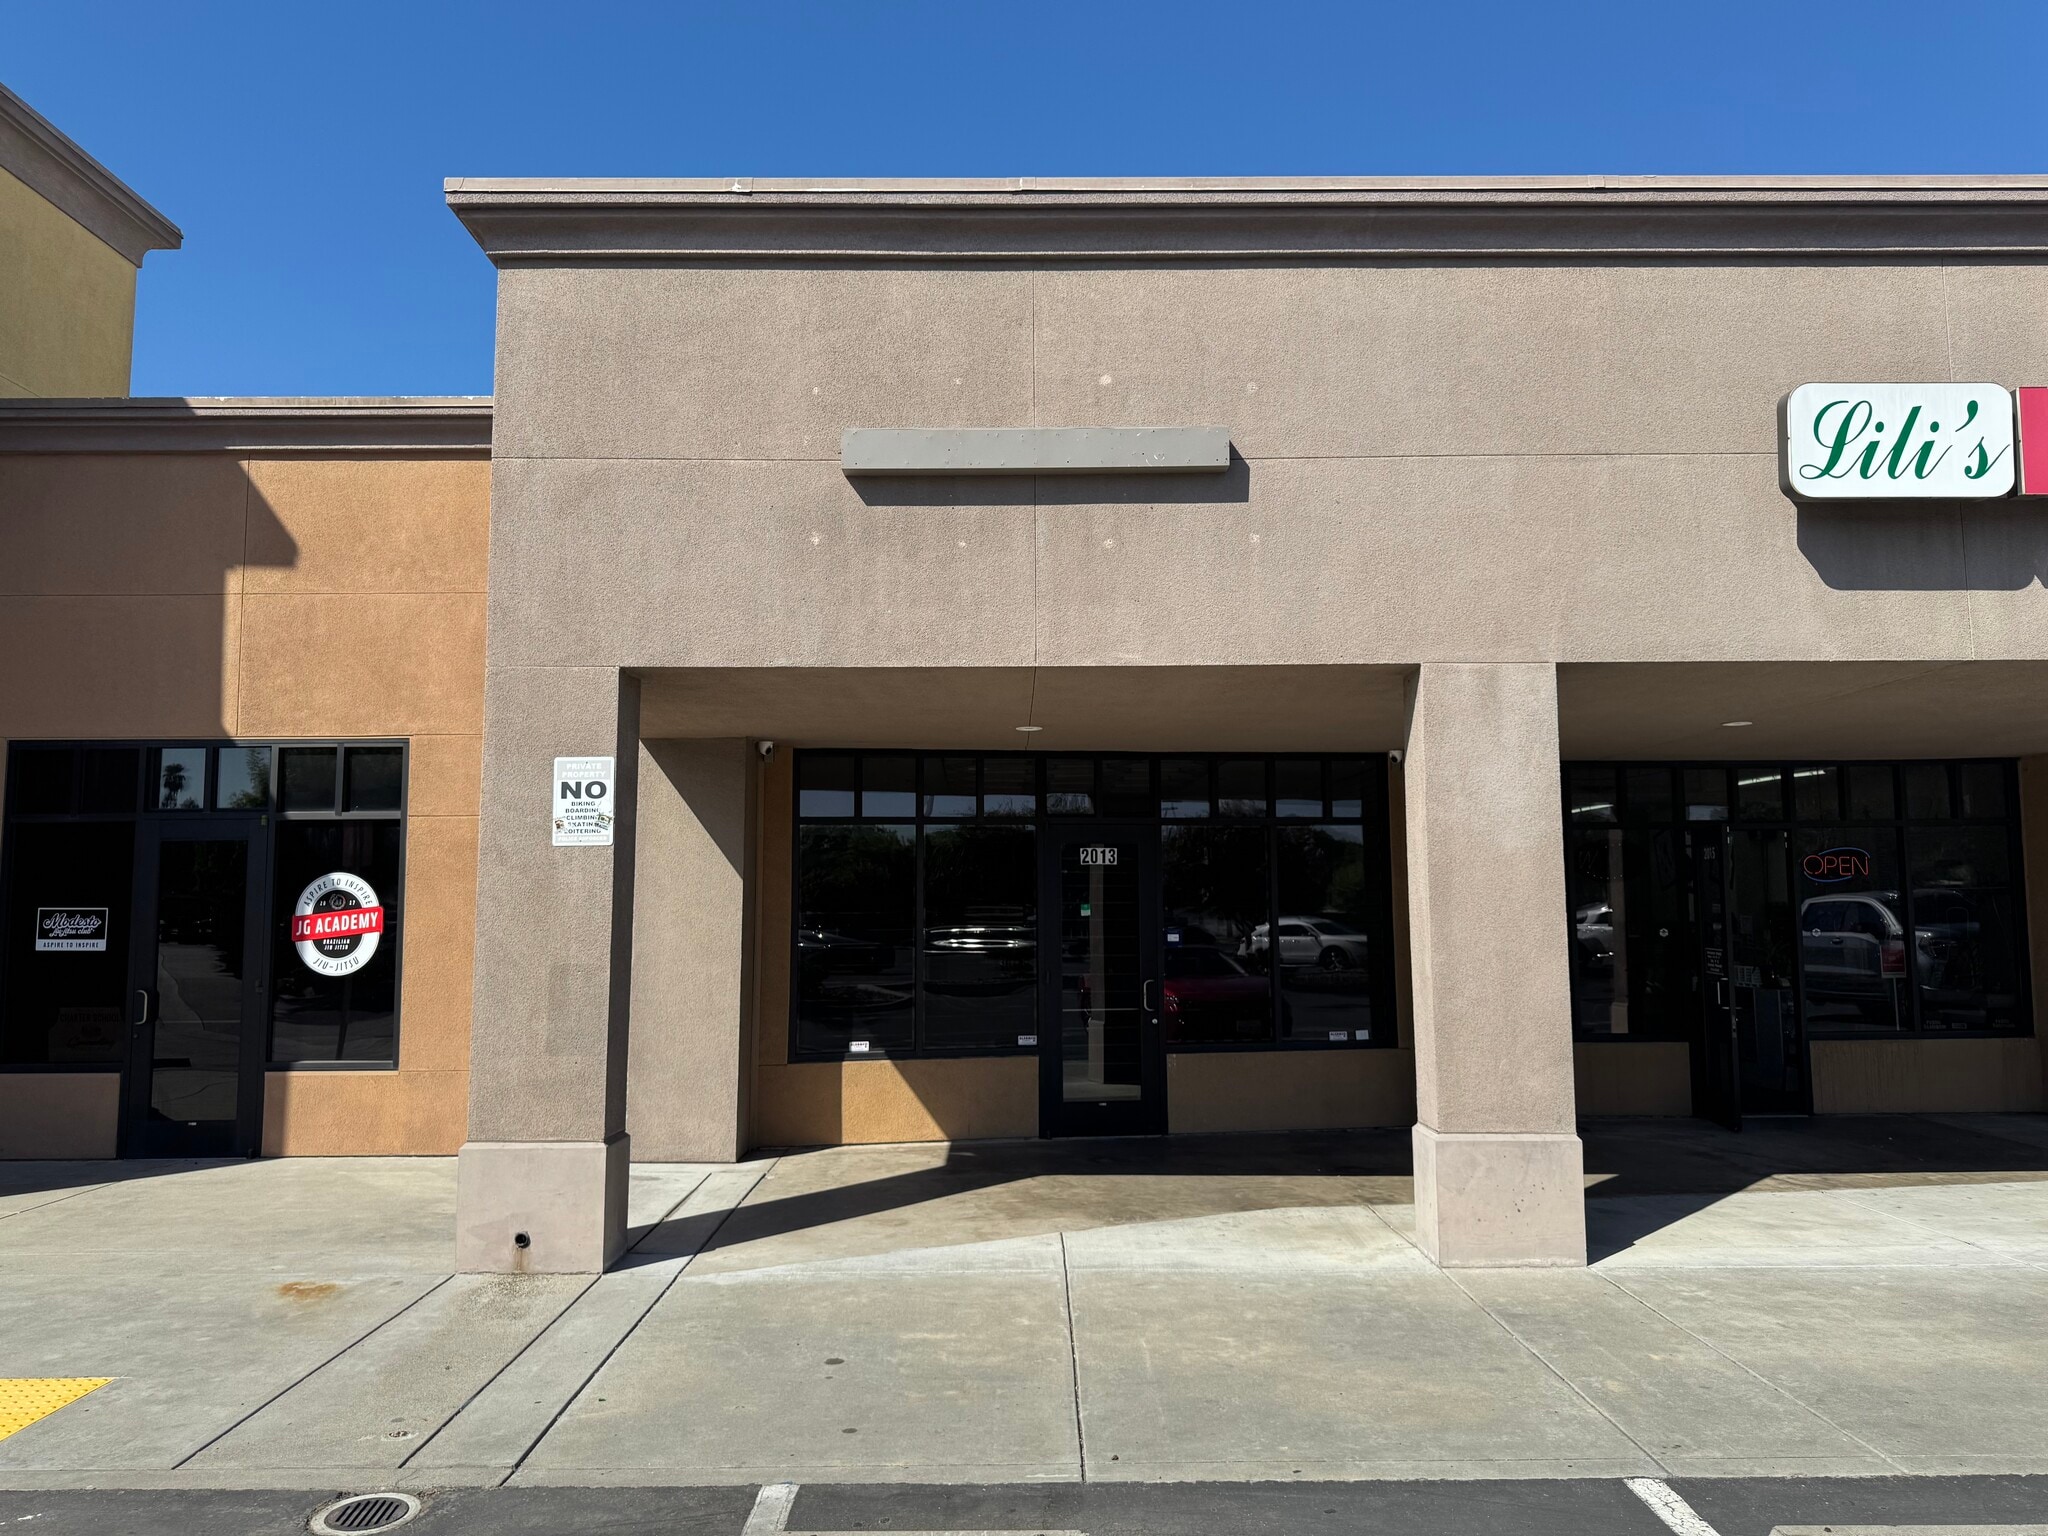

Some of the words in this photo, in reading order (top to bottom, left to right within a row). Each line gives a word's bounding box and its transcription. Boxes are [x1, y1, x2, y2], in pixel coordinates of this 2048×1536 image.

[1800, 400, 2010, 480] Lili's
[561, 781, 607, 799] NO
[1081, 848, 1116, 864] 2013
[1803, 855, 1869, 876] OPEN
[304, 881, 328, 907] ASPIRE
[331, 878, 341, 886] TO
[345, 879, 373, 905] INSPIRE
[42, 912, 102, 928] Modesto
[296, 919, 311, 936] JG
[315, 911, 379, 934] ACADEMY
[313, 956, 359, 972] JIU-JITSU
